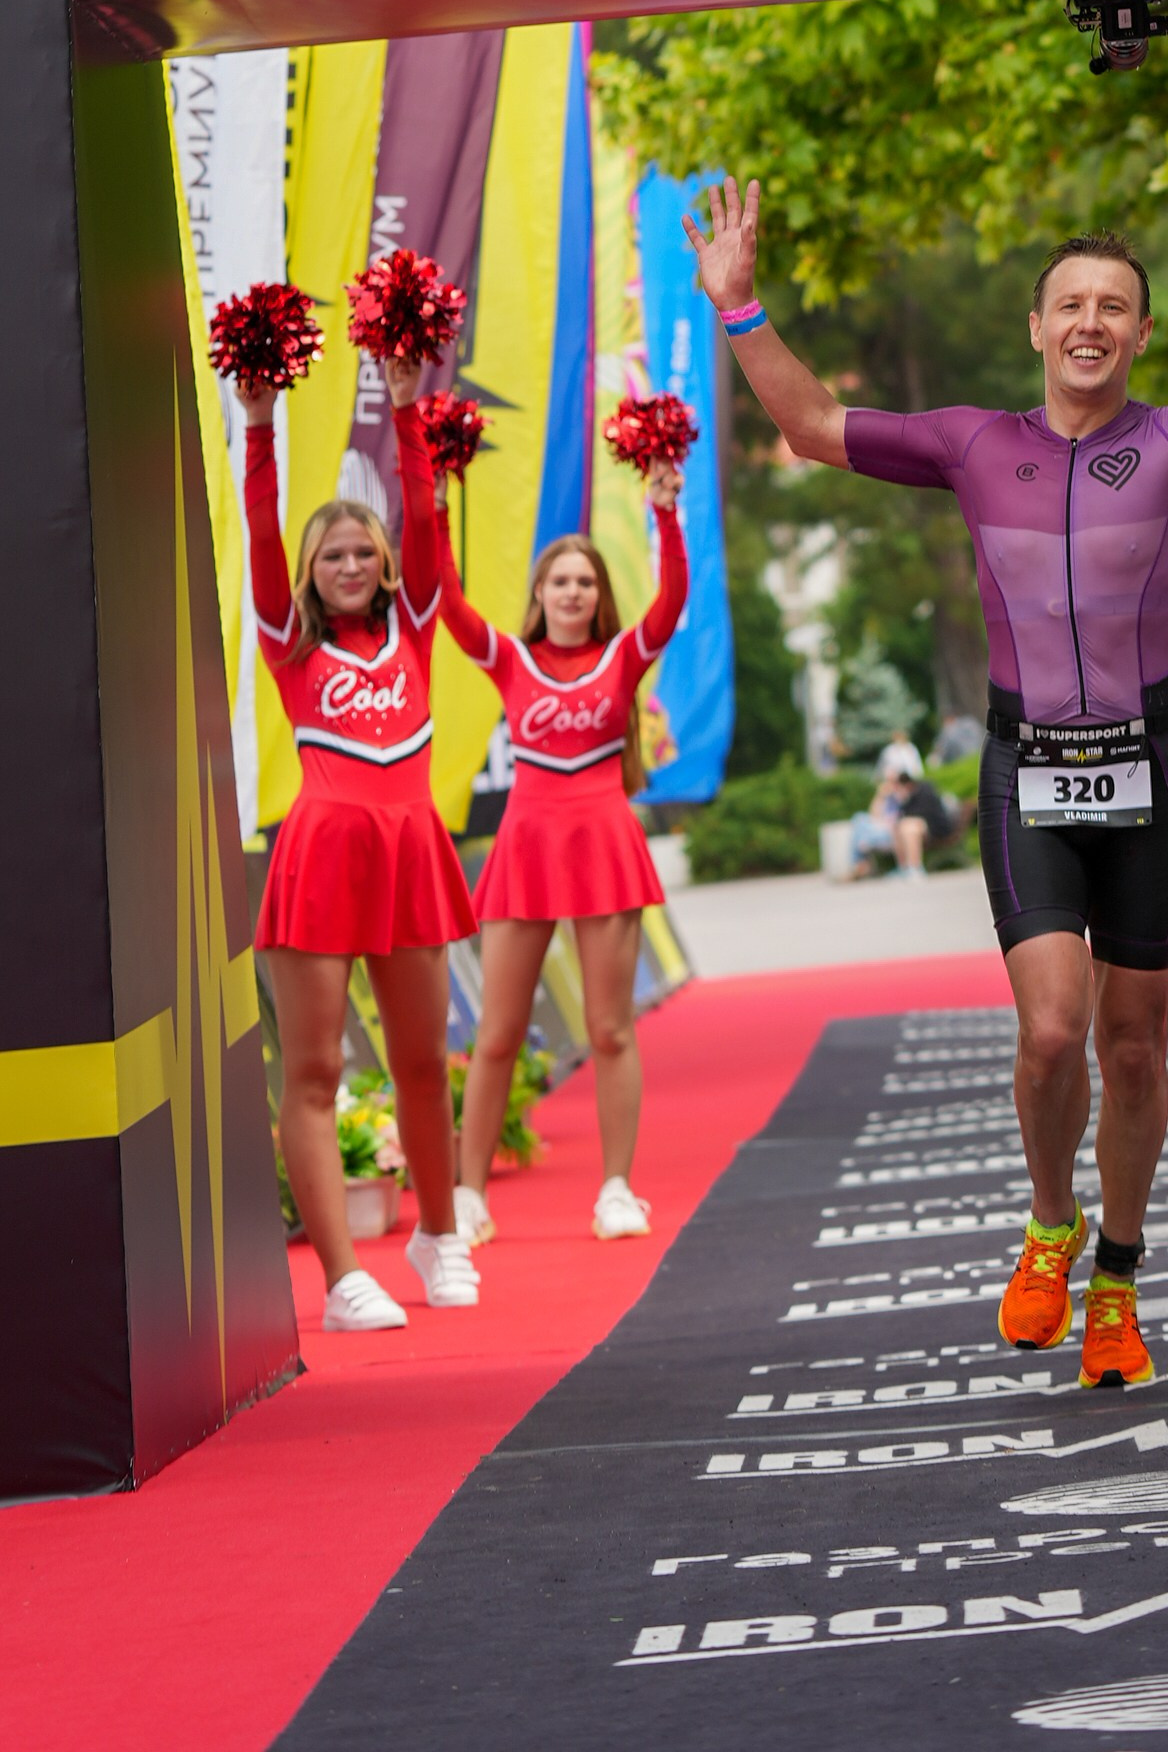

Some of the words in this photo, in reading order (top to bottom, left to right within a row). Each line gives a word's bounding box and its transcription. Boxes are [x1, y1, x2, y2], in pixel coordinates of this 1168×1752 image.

[187, 51, 218, 298] ПРЕМИУ
[321, 661, 407, 718] Cool
[519, 695, 613, 742] Cool
[1049, 725, 1127, 742] SUPERSPORT
[1053, 774, 1115, 804] 320
[1064, 810, 1108, 823] VLADIMIR
[737, 1371, 1052, 1413] IRON
[706, 1429, 1055, 1474] IRON
[631, 1588, 1084, 1656] IRON
